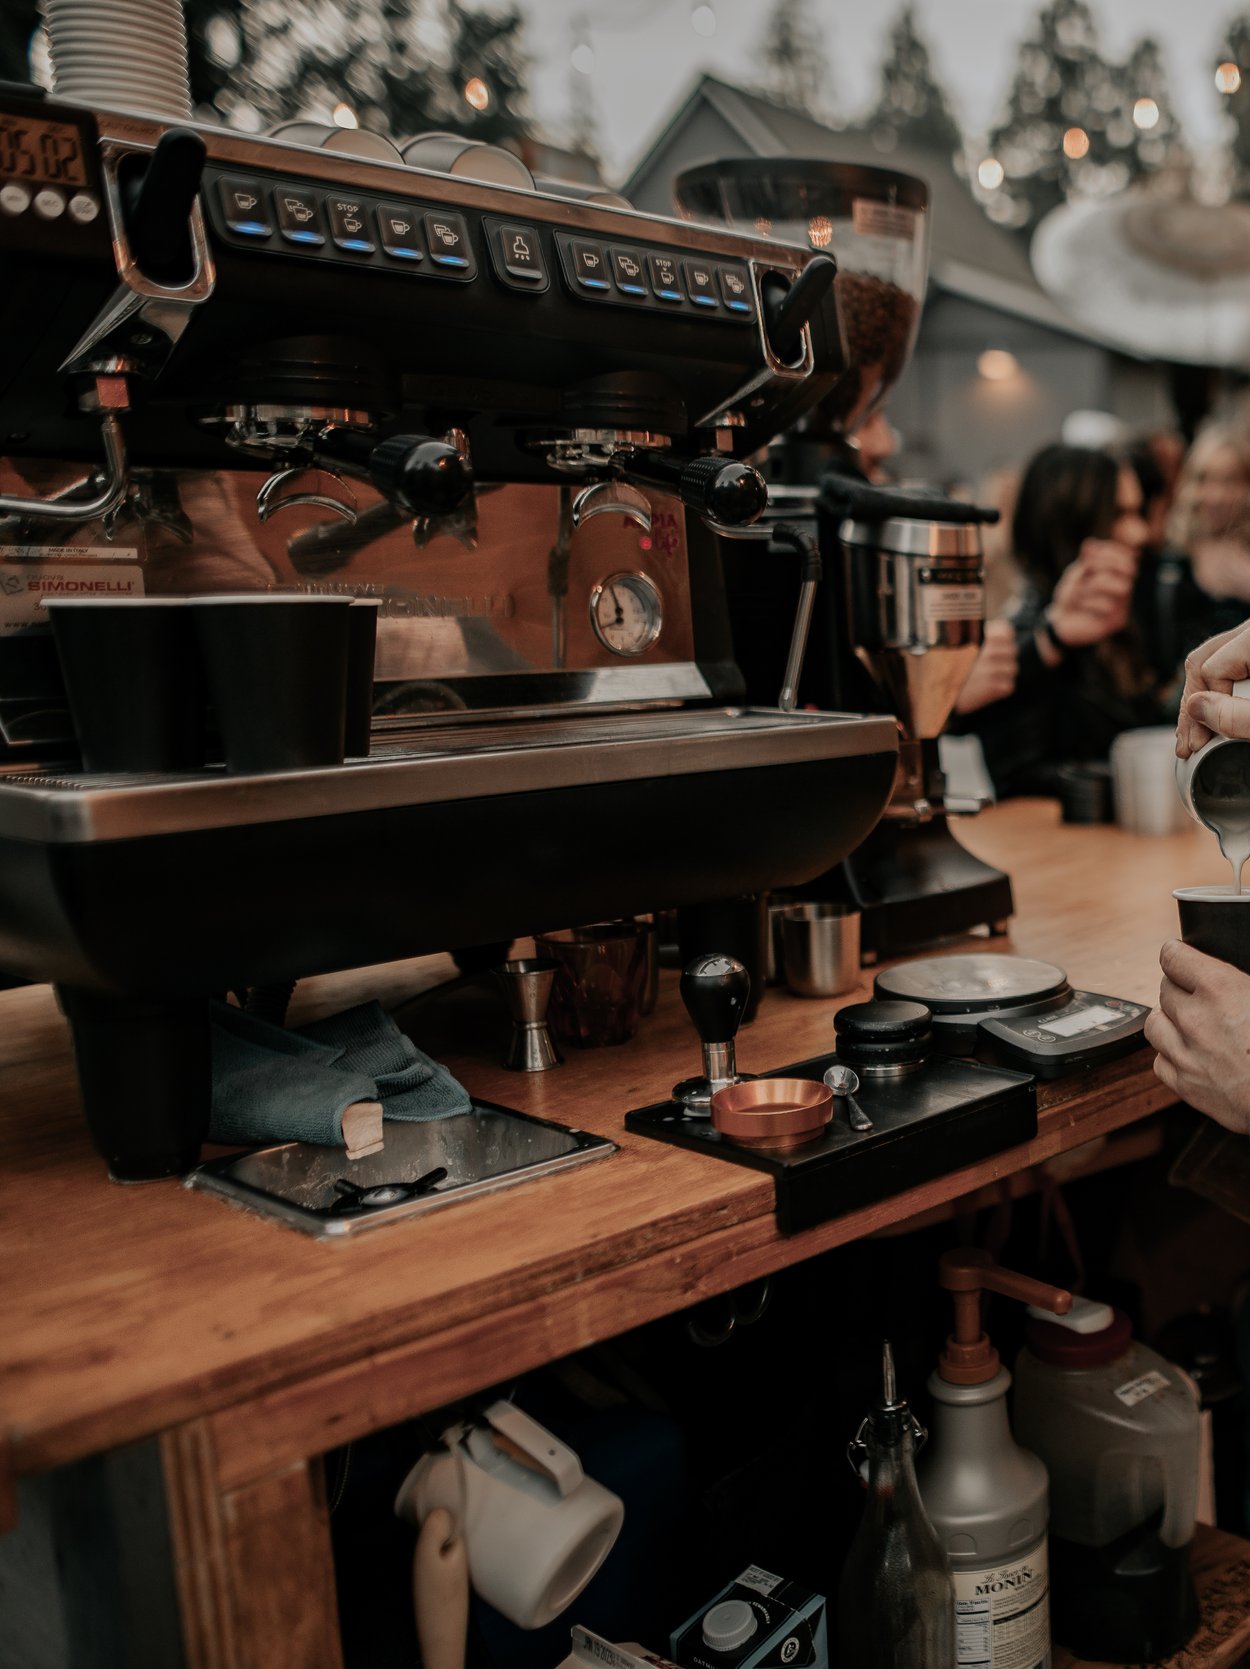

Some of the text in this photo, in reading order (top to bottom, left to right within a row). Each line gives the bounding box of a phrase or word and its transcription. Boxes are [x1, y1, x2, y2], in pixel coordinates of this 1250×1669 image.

[337, 203, 359, 212] STOP
[655, 258, 672, 267] STOP
[28, 581, 131, 591] SIMONELLI
[975, 1572, 1033, 1596] MONIN
